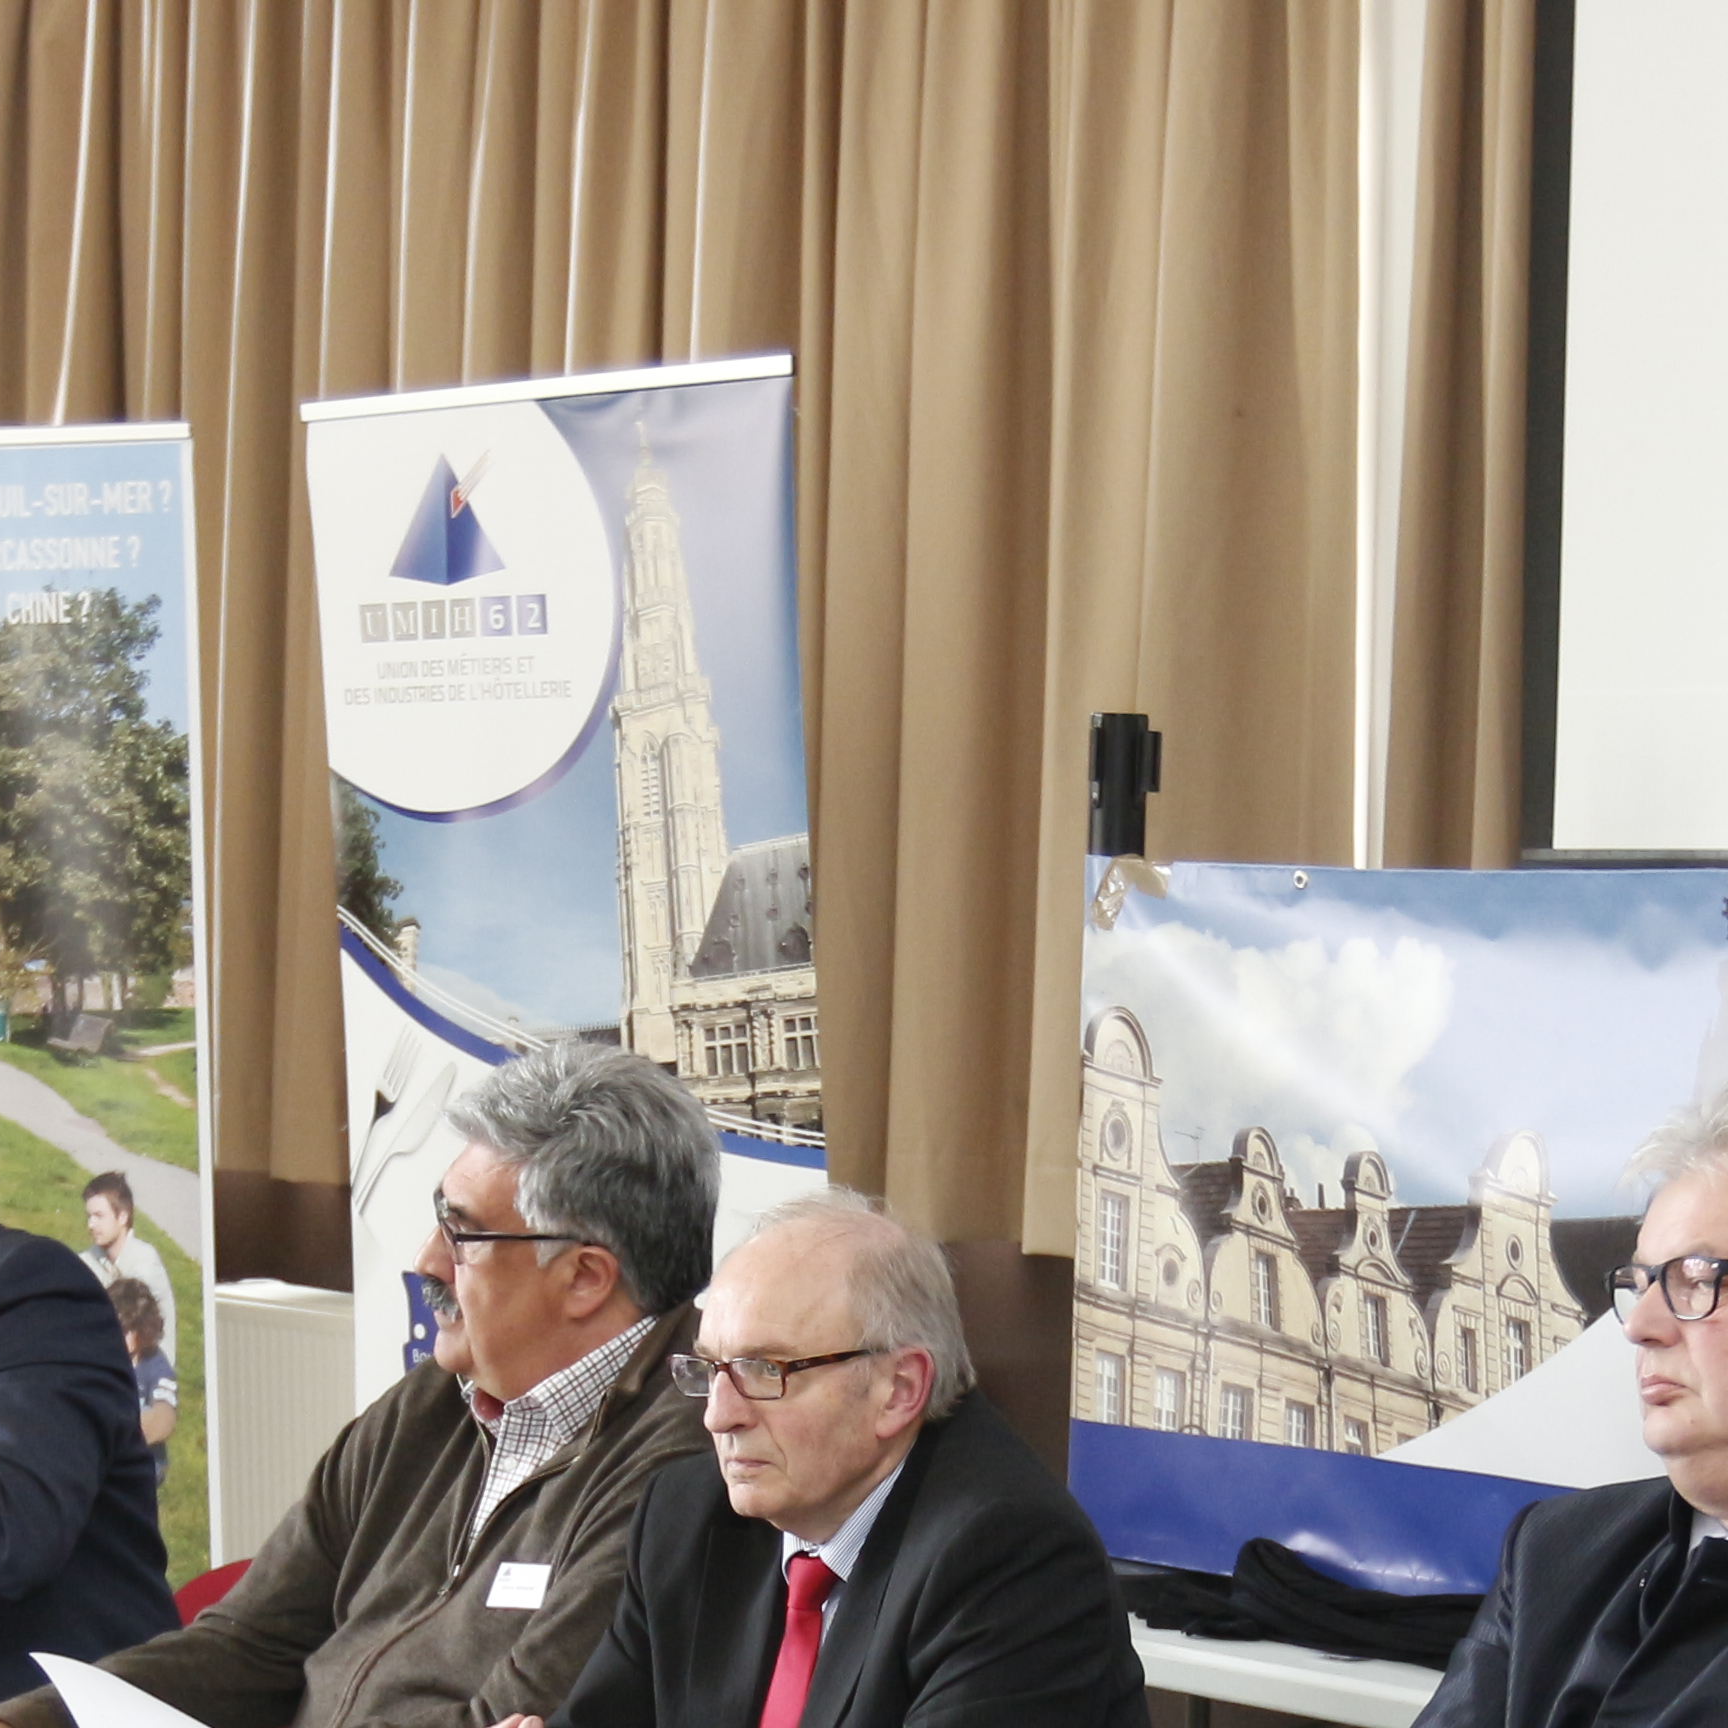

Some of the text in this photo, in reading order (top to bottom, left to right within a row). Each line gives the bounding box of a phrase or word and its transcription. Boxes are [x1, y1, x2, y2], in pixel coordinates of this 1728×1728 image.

[6, 590, 73, 625] CHINE
[364, 602, 542, 638] UMIH 62
[377, 653, 535, 680] UNION DES MÉTIERS ET
[344, 677, 573, 706] DES INDUSTRIES DE L'HÔTELLERIE
